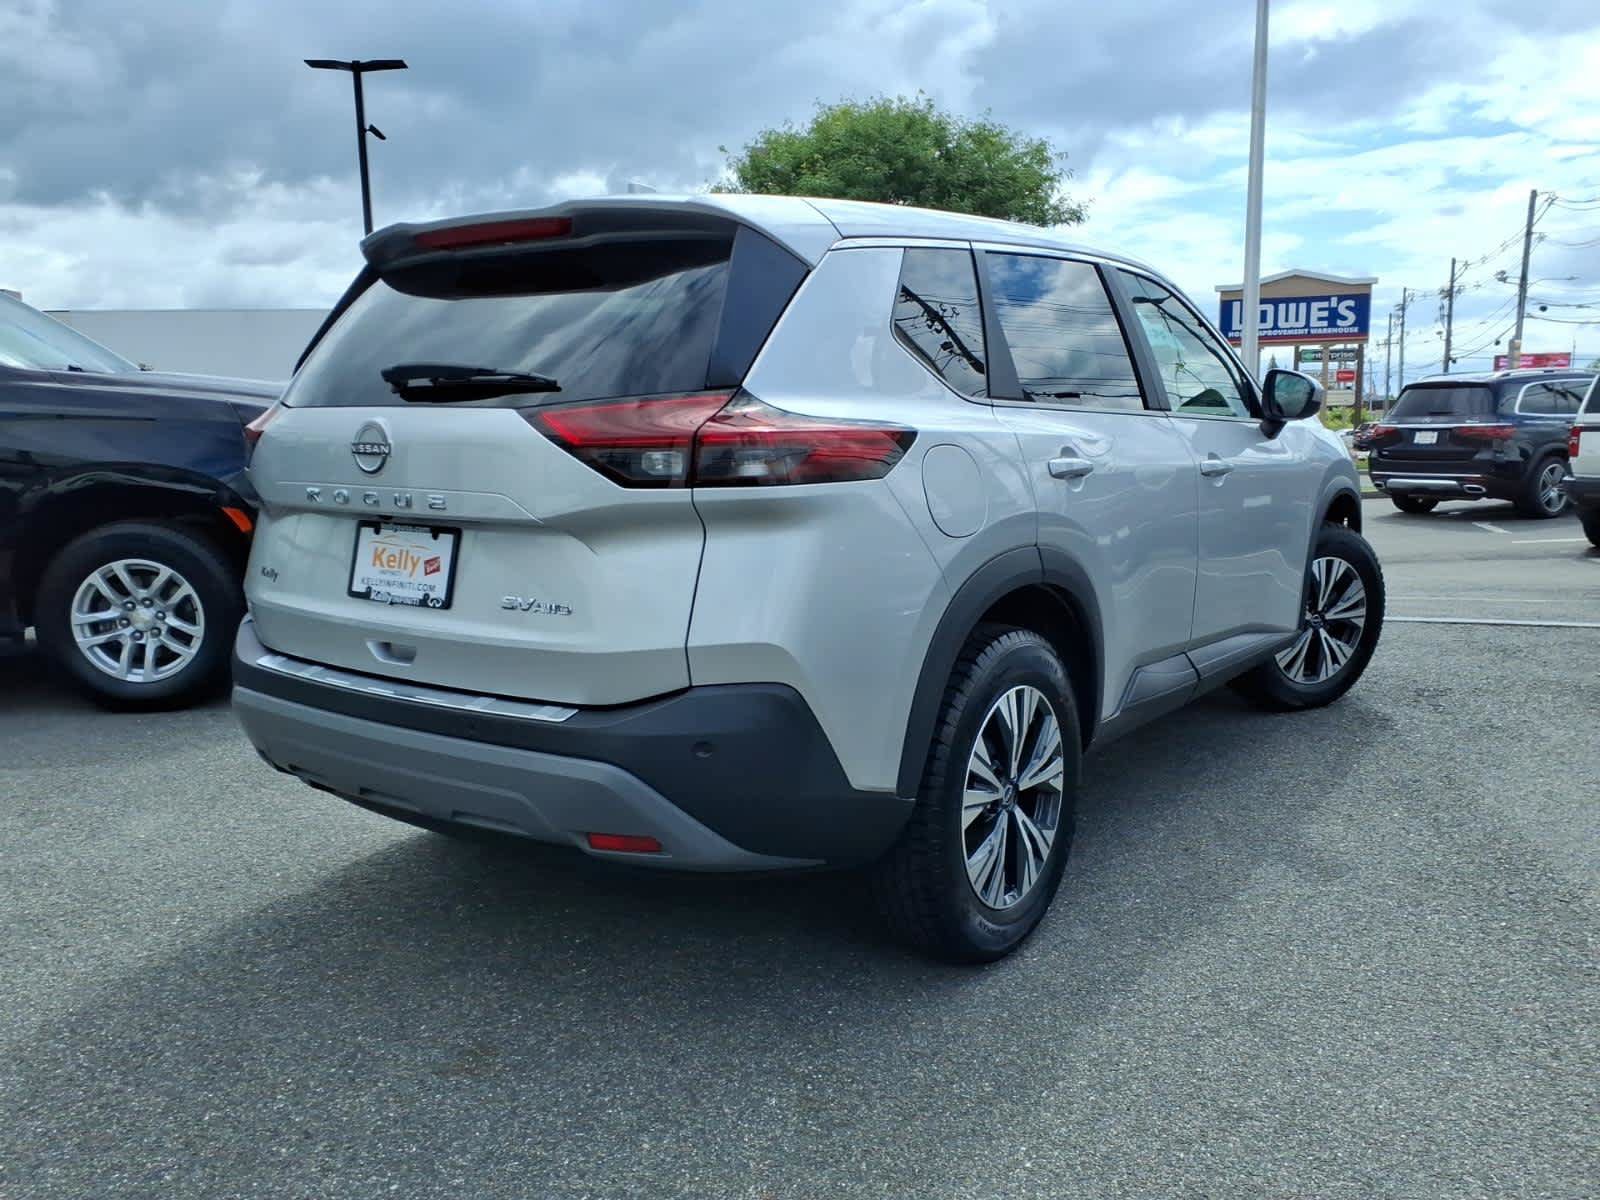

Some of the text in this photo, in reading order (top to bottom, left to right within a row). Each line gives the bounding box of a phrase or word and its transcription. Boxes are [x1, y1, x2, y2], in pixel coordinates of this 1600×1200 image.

[1232, 297, 1357, 330] LOWE'S
[1257, 328, 1309, 336] MPROVEMENT
[352, 444, 390, 454] NISSAN
[305, 486, 448, 511] ROGUE
[372, 547, 421, 577] Kelly
